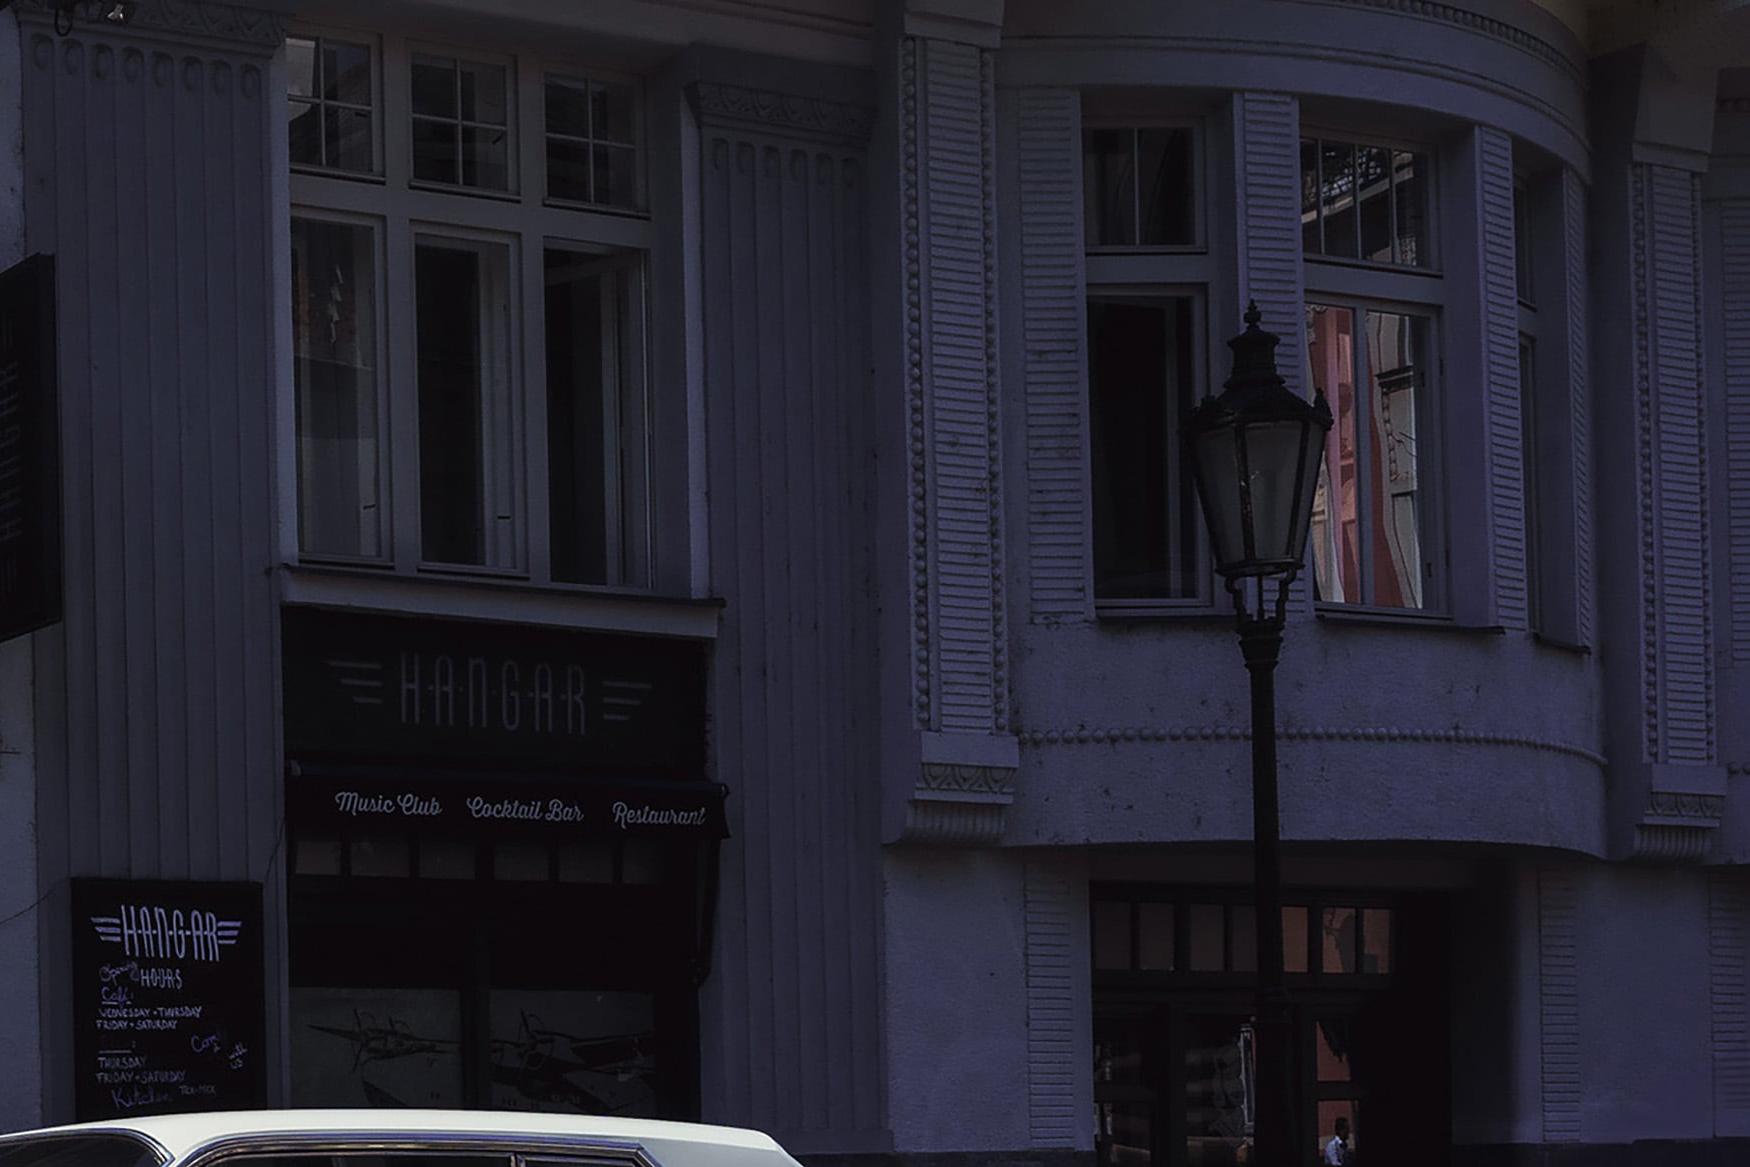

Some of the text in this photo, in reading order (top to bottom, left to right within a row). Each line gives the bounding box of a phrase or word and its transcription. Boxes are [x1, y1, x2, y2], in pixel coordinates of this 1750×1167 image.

[400, 651, 586, 737] HANGAR
[335, 792, 443, 816] Music Club
[467, 796, 584, 823] Cocktail Bar
[612, 801, 707, 829] Restaurant
[121, 904, 220, 962] HANGAR
[140, 968, 184, 989] HOURS
[99, 1005, 203, 1019] WEDNESDAY THURSDAY
[96, 1019, 179, 1030] FRIDAY SATURDAY
[98, 1056, 147, 1069] THURSDAY
[96, 1070, 186, 1084] FRIDAY SATURDAY
